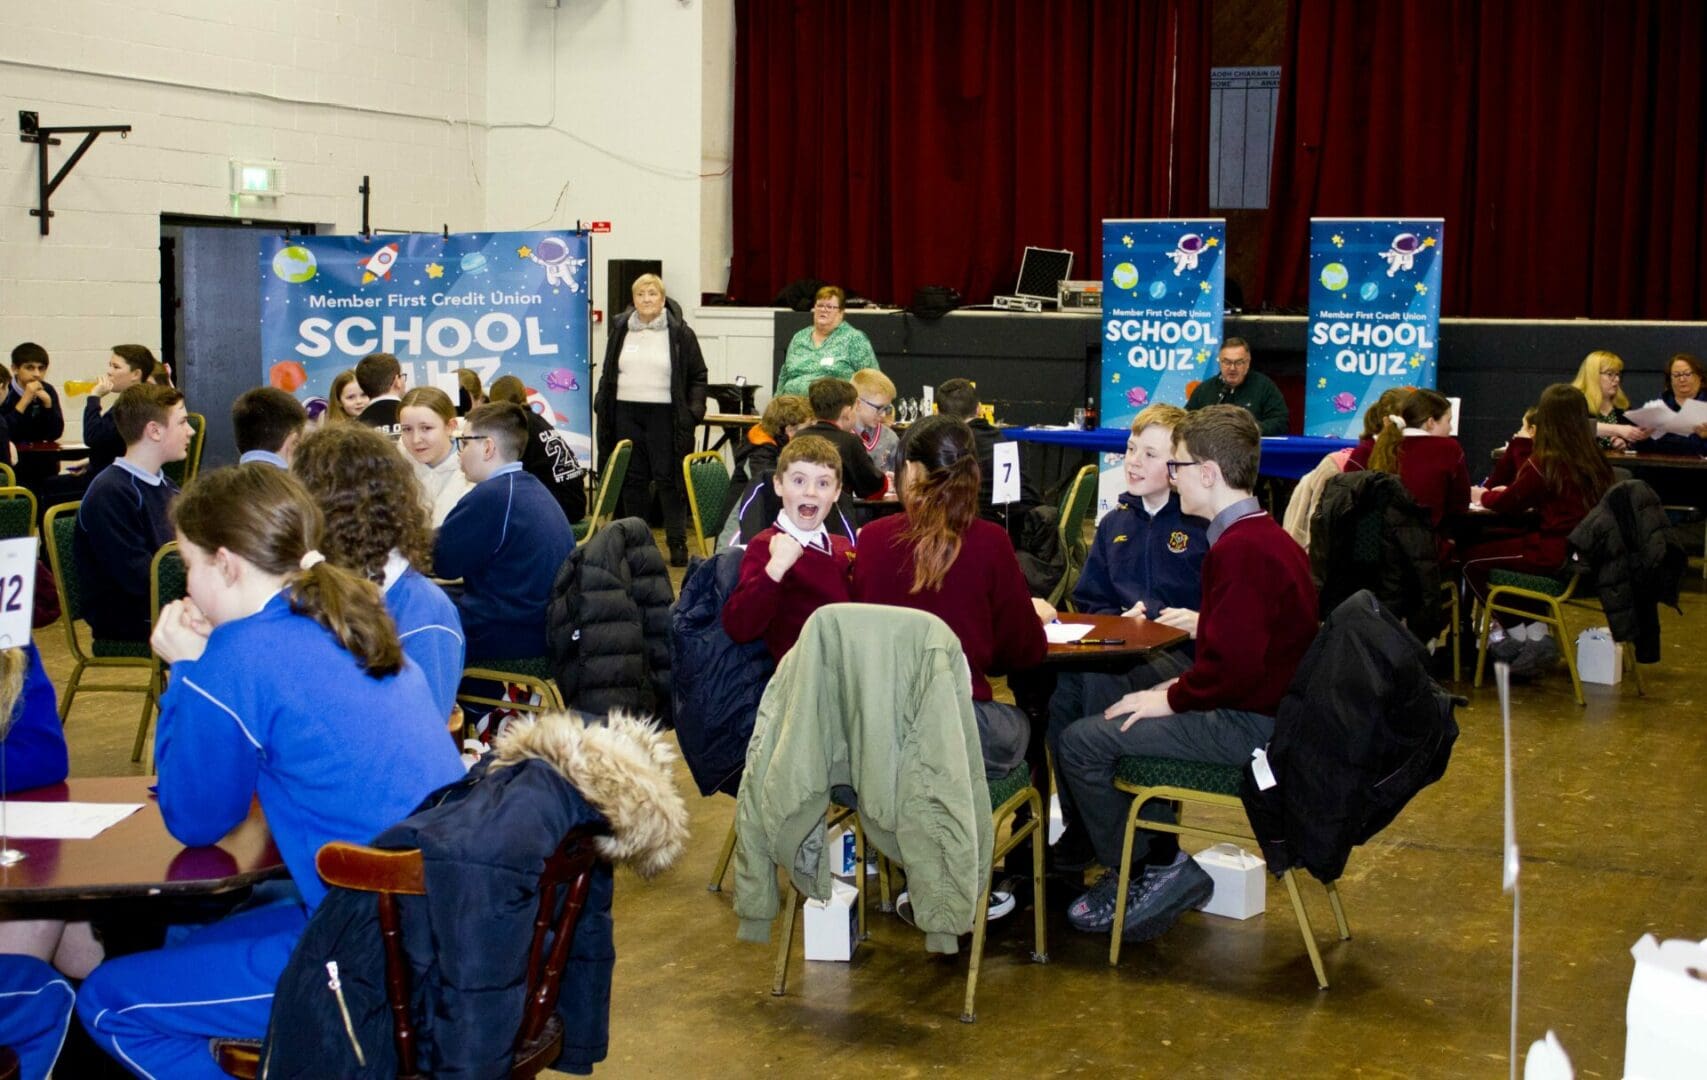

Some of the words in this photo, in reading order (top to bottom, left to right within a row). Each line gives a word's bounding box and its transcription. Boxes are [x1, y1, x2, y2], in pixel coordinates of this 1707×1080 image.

[309, 294, 382, 308] Member
[388, 293, 426, 307] First
[432, 292, 486, 306] Credit
[491, 292, 542, 305] Union
[1112, 308, 1144, 317] Member
[1146, 308, 1162, 317] First
[1164, 309, 1187, 318] Credit
[1189, 310, 1211, 318] Union
[1320, 310, 1354, 319] Member
[1356, 311, 1374, 320] First
[1375, 311, 1400, 320] Credit
[1402, 312, 1427, 320] Union
[295, 312, 559, 357] SCHOOL
[1105, 319, 1218, 345] SCHOOL
[1312, 322, 1434, 349] SCHOOL
[1128, 345, 1194, 371] QUIZ
[1335, 349, 1407, 376] QUIZ
[1003, 462, 1012, 483] 7
